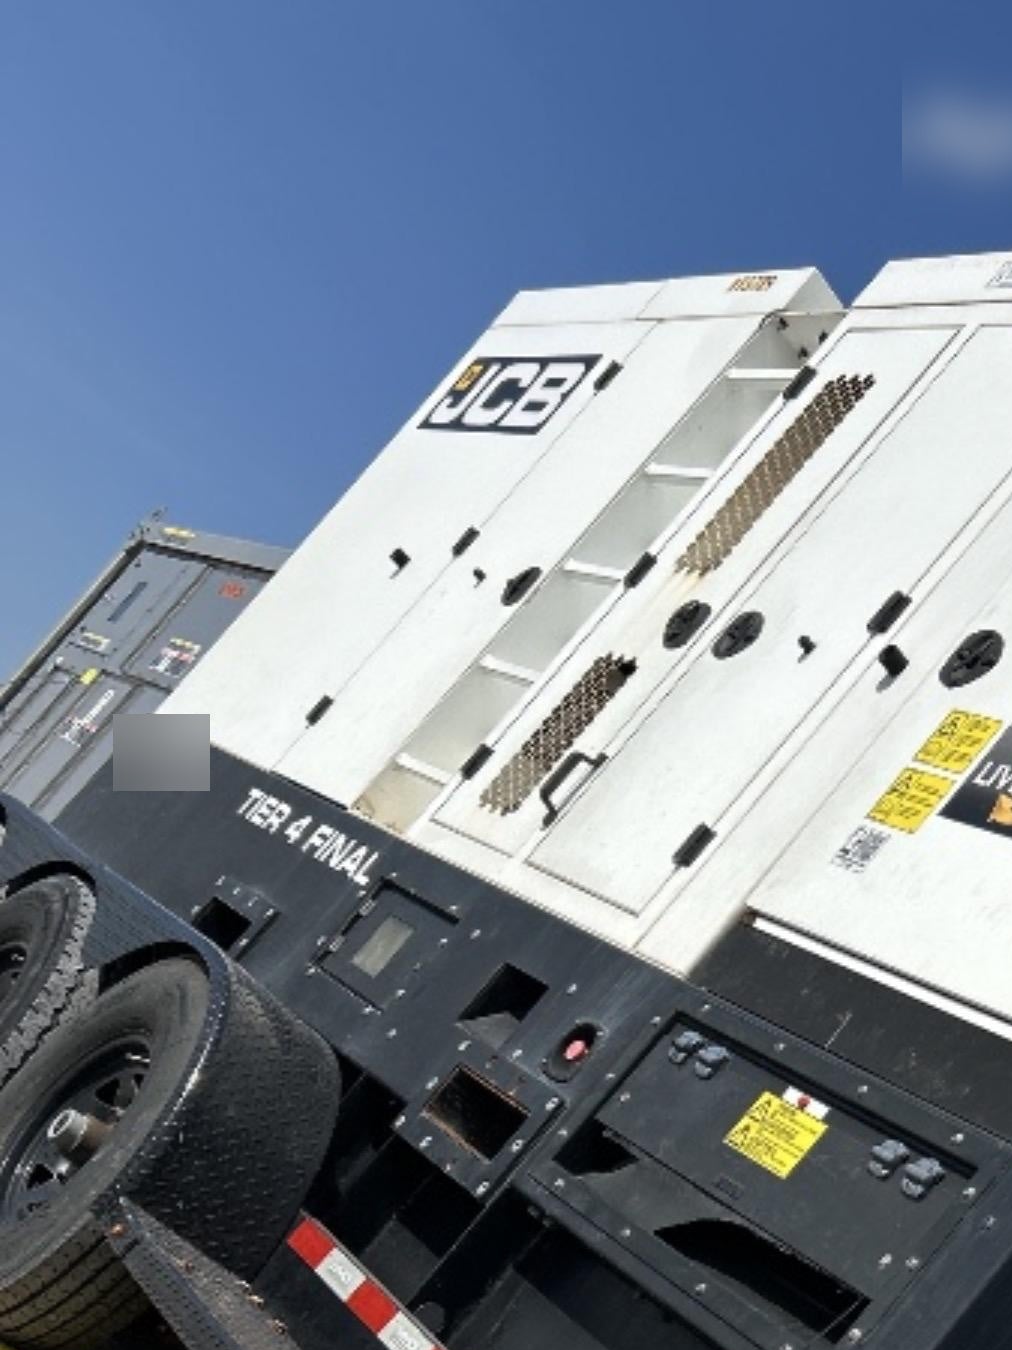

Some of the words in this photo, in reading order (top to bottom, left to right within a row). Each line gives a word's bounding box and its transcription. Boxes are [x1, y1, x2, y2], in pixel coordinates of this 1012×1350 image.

[428, 361, 586, 427] JCB
[237, 788, 292, 833] TIER
[284, 815, 313, 844] 4
[302, 824, 379, 885] FINAL
